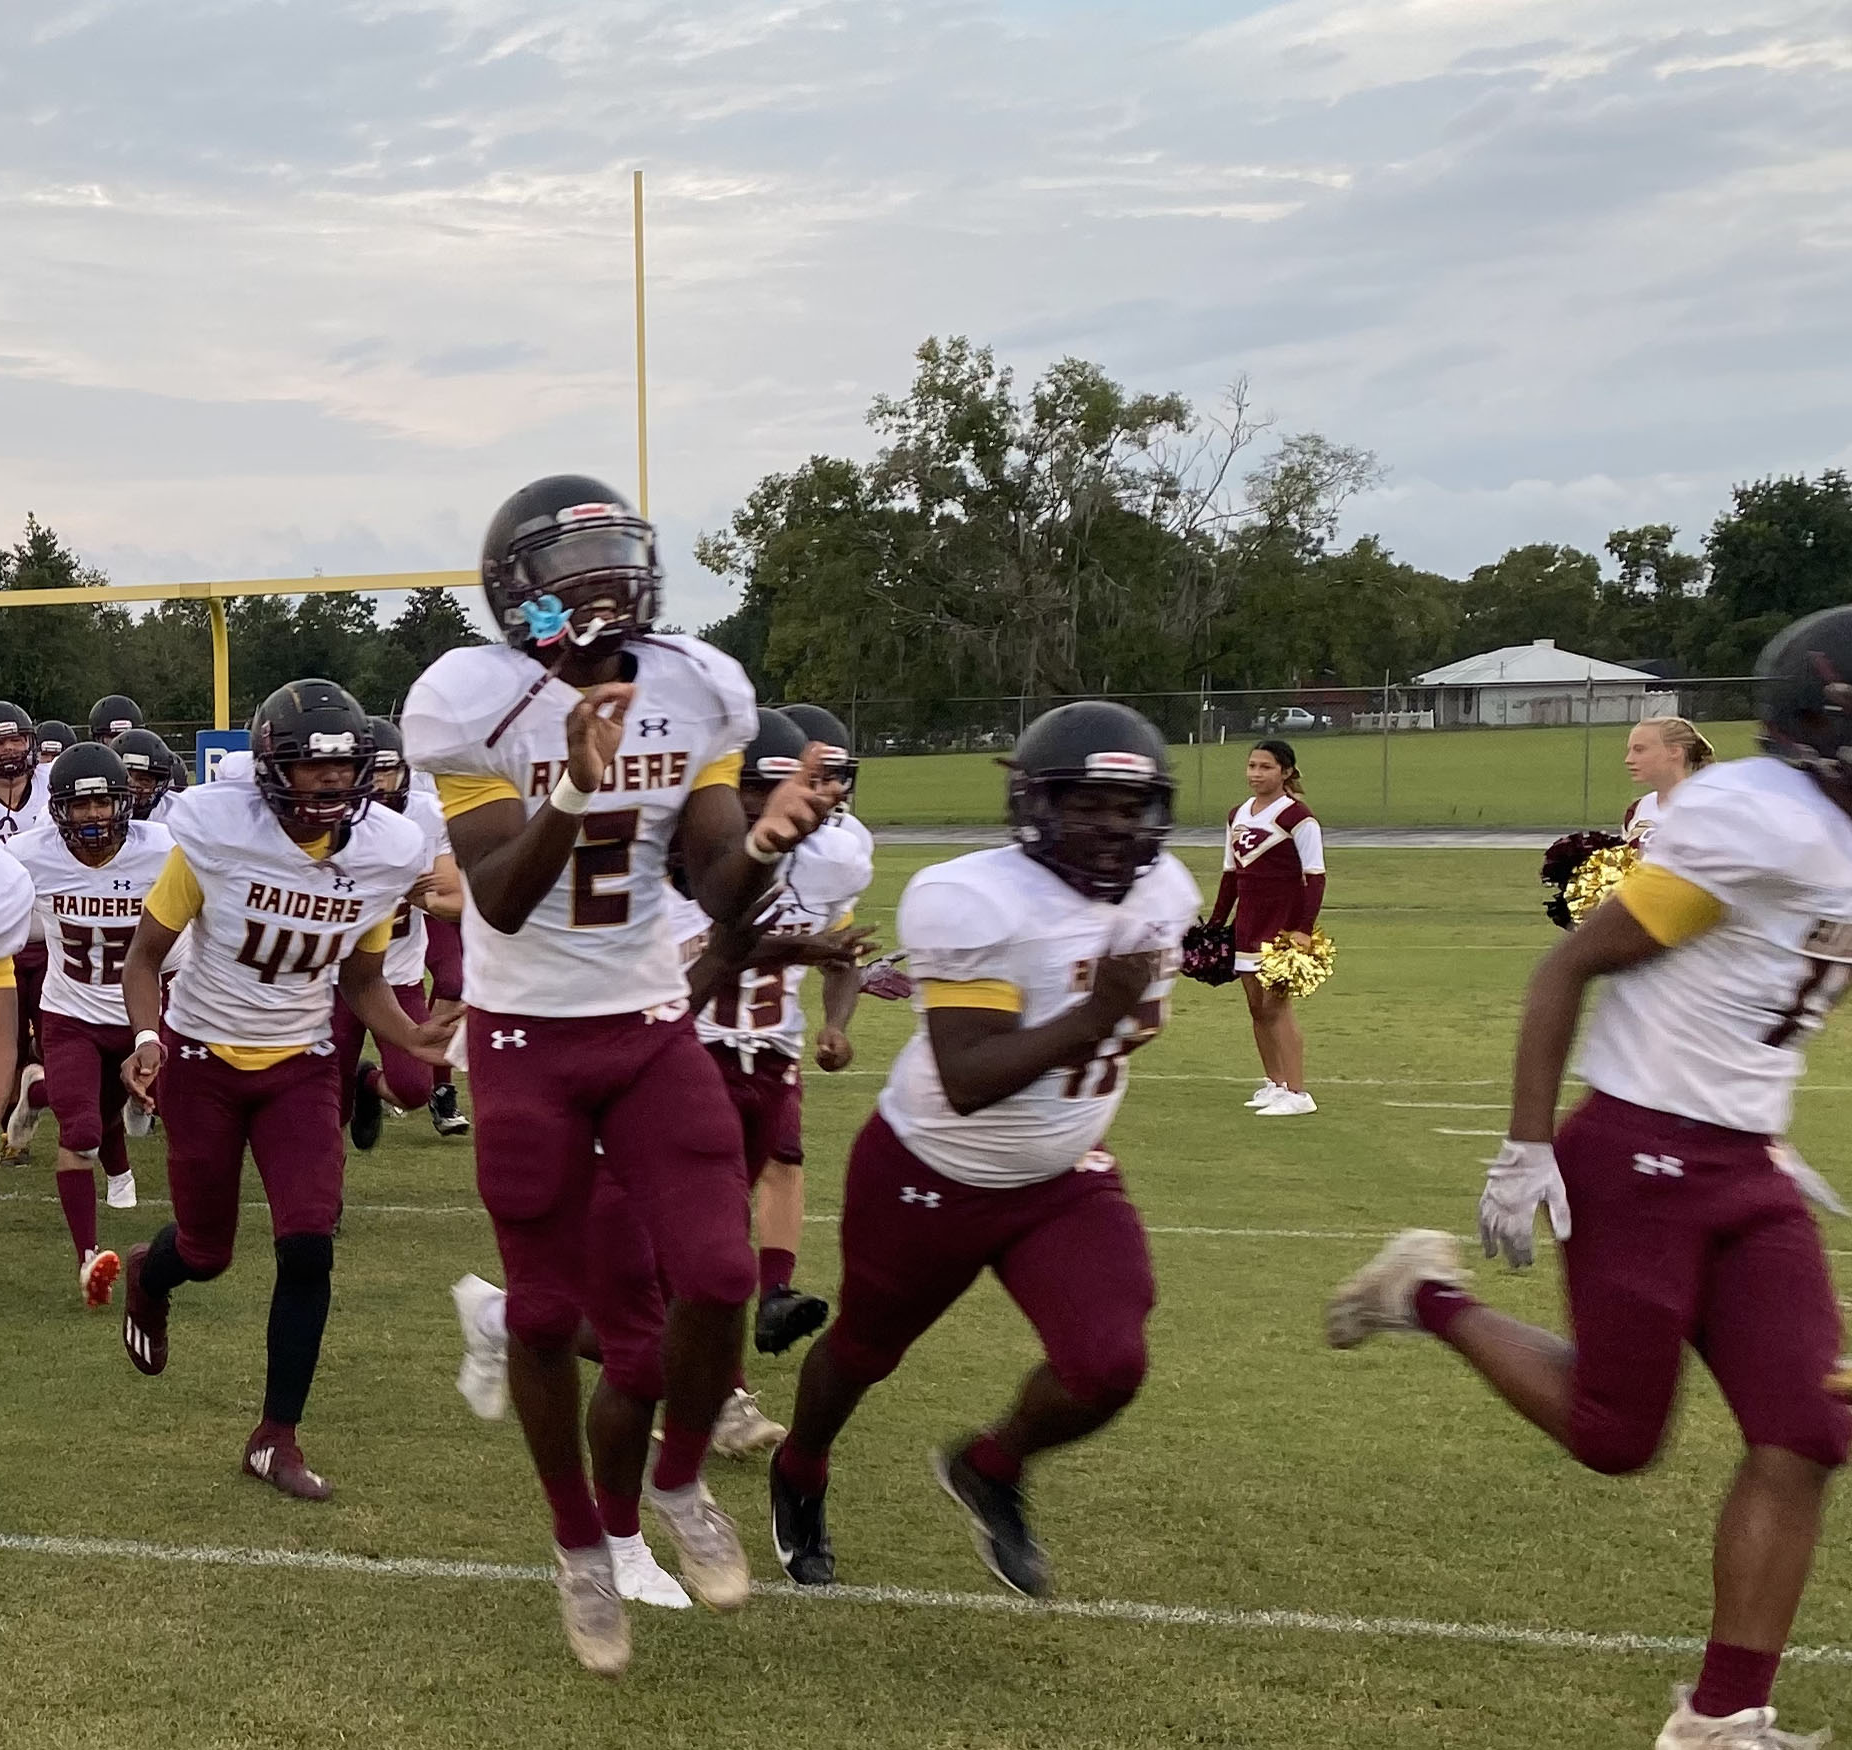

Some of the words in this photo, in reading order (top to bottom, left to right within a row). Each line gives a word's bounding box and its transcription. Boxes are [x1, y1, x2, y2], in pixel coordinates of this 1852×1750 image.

[529, 752, 690, 798] RDERS
[1239, 831, 1257, 849] CC
[569, 807, 641, 929] 2
[52, 895, 143, 917] RAIDERS
[246, 881, 364, 923] RAIDERS
[59, 920, 137, 986] 32
[235, 918, 345, 985] 44
